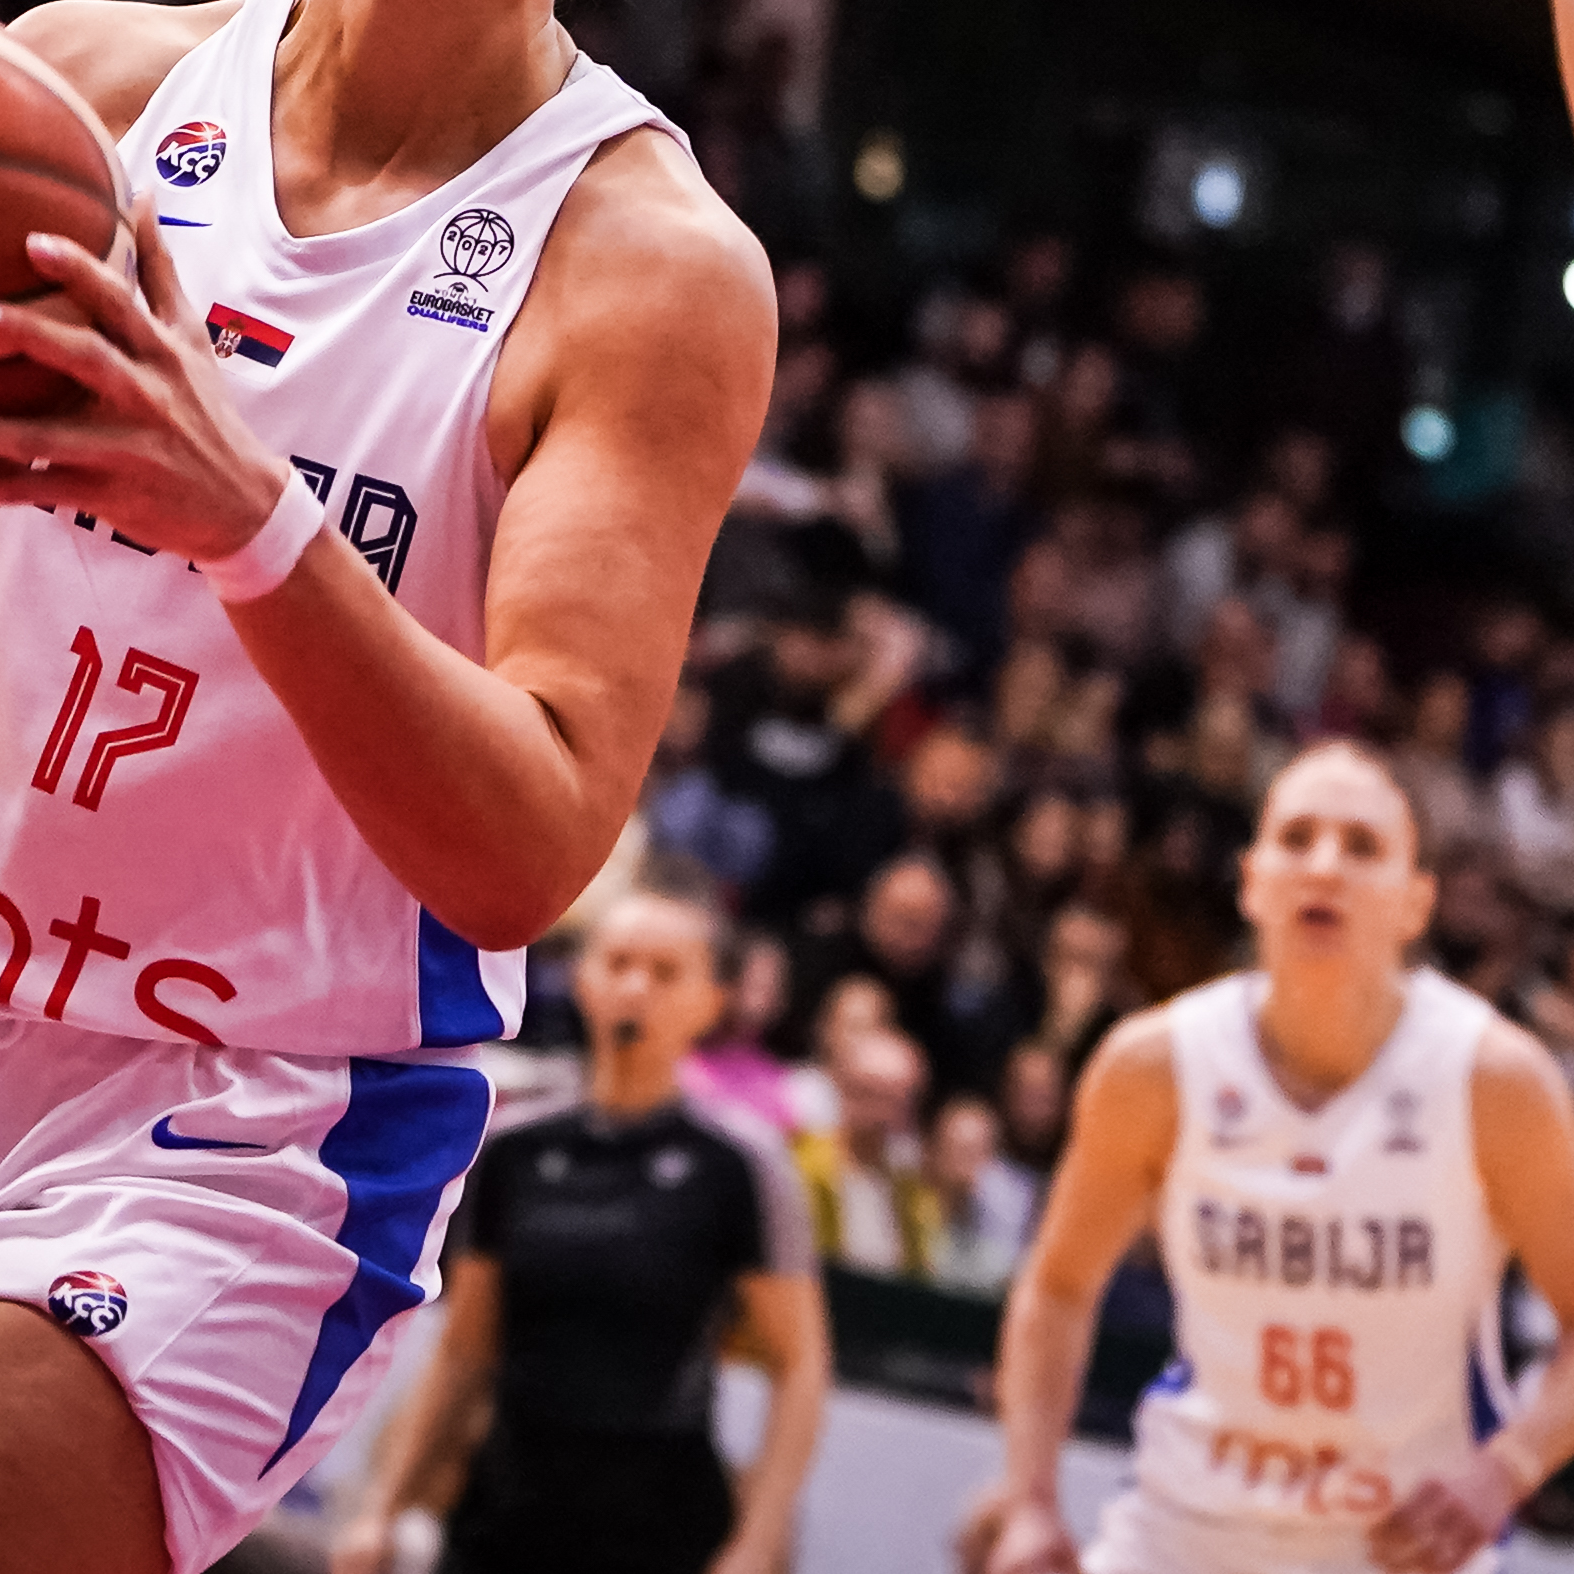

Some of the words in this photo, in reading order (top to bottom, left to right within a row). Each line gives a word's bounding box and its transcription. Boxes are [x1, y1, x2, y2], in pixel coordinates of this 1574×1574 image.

[446, 230, 509, 256] 2027
[406, 304, 489, 333] QUALIFIERS
[409, 290, 496, 324] EUROBASKET
[30, 625, 200, 813] 17
[1259, 1325, 1359, 1412] 66
